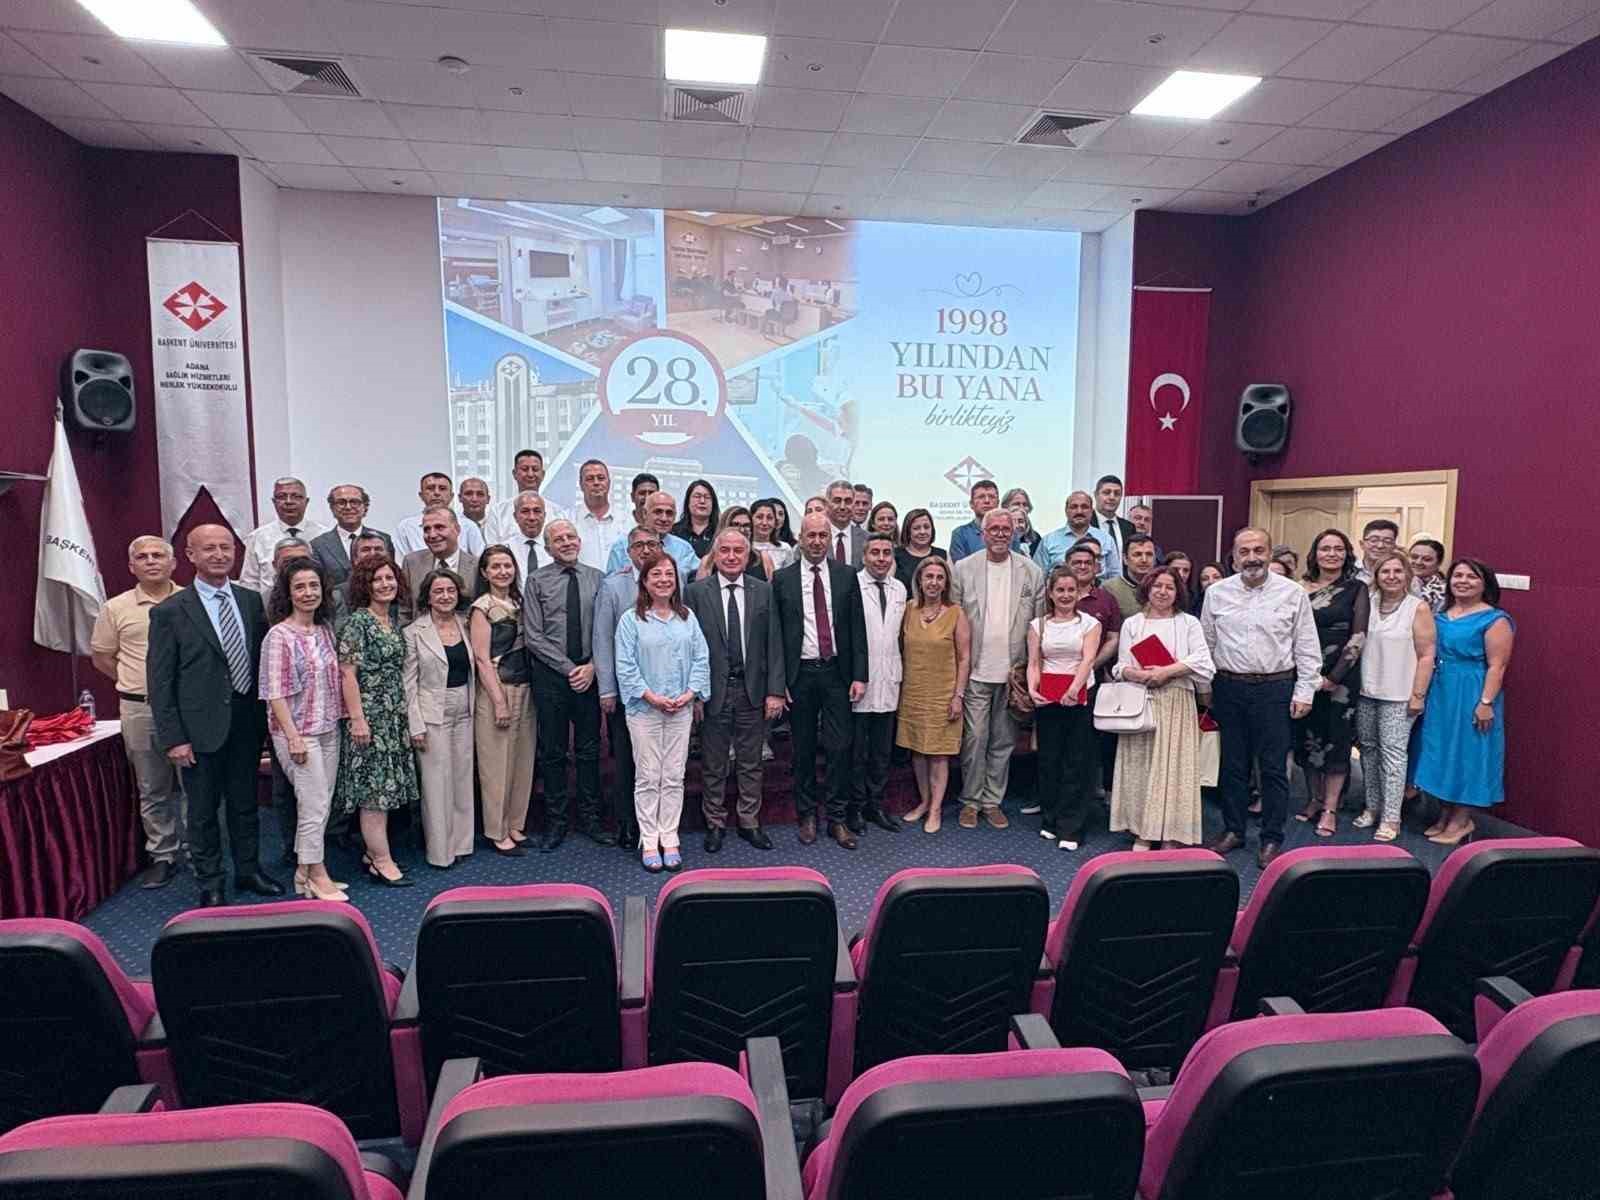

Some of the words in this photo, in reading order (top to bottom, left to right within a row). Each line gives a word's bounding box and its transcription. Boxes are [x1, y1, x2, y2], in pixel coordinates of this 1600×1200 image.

[936, 308, 1009, 336] 1998
[889, 341, 1055, 371] YILINDAN
[626, 356, 708, 406] 28.
[896, 373, 944, 399] BU
[954, 375, 1044, 401] YANA
[651, 413, 677, 426] YIL
[924, 403, 1015, 434] birlikteyiz
